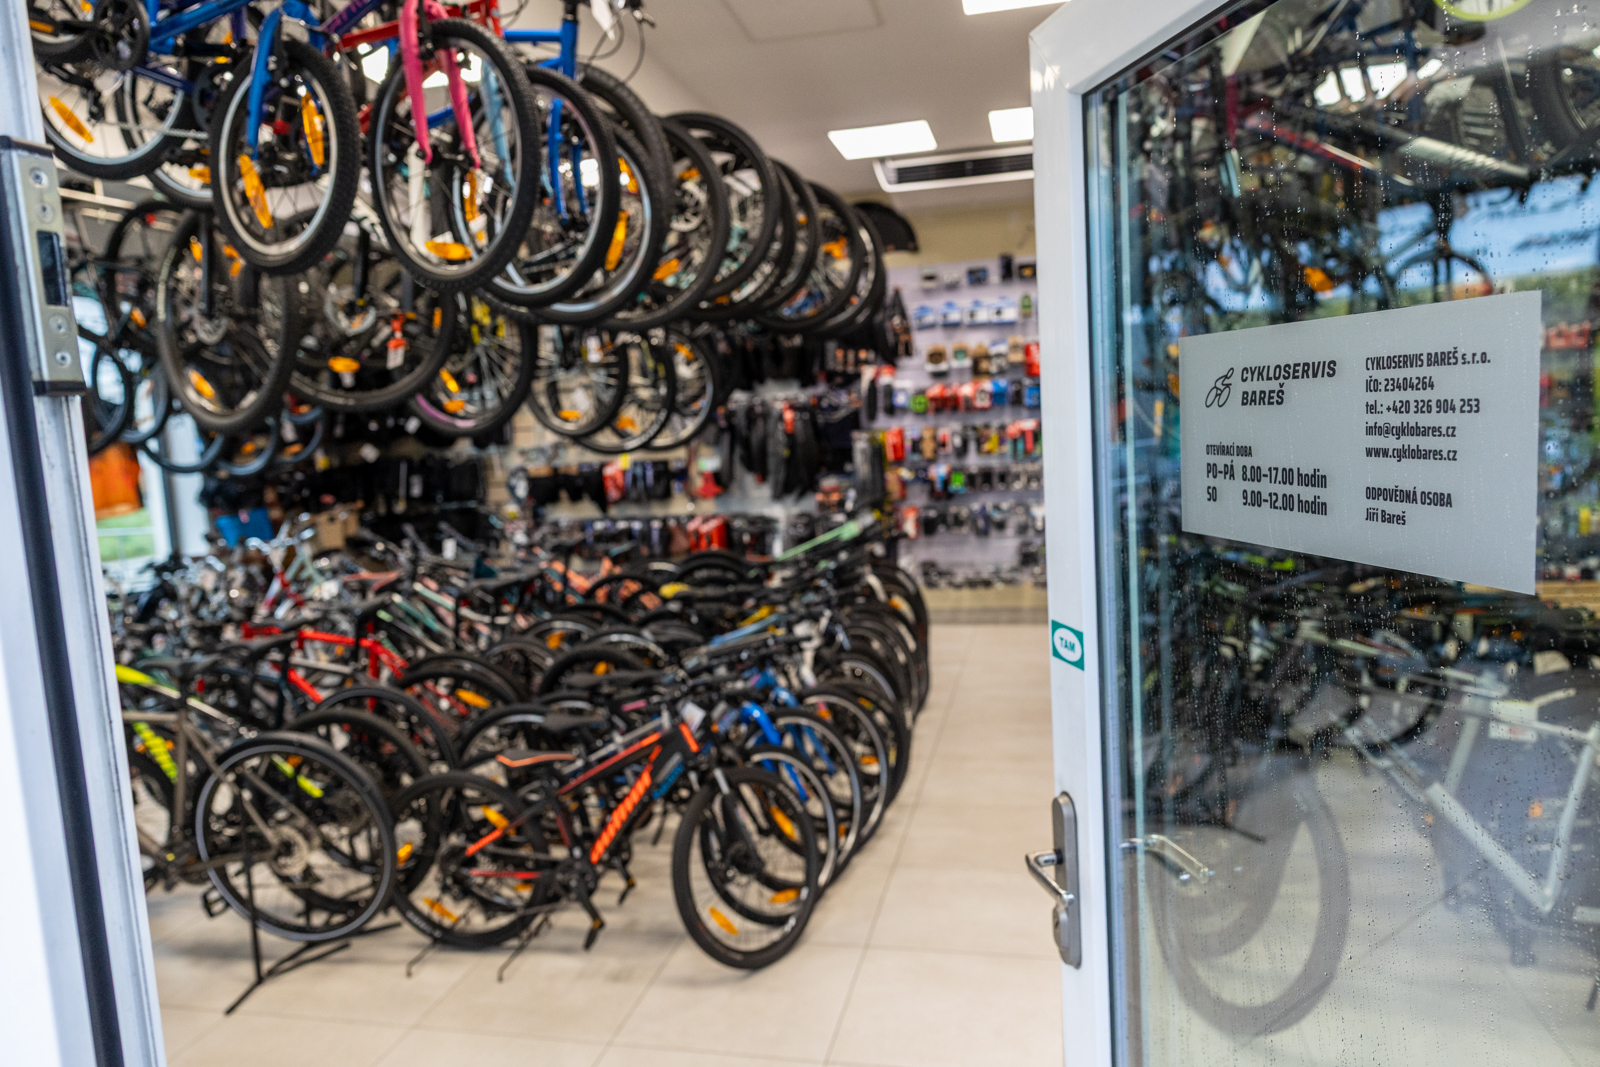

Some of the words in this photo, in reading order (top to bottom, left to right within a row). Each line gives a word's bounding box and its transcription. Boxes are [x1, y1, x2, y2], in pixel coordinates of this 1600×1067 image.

[1365, 353, 1424, 371] CYKLOSERVIS
[1426, 346, 1459, 367] BAREŠ
[1461, 351, 1491, 365] s.r.o.
[1240, 360, 1337, 382] CYKLOSERVIS
[1365, 375, 1382, 393] IČO:
[1384, 376, 1435, 392] 23404264
[1241, 382, 1285, 406] BAREŠ
[1365, 399, 1384, 415] tel.:
[1385, 399, 1411, 415] +420
[1413, 399, 1433, 414] 326
[1435, 398, 1456, 414] 904
[1459, 398, 1481, 414] 253
[1365, 421, 1457, 440] info@cyklobares.cz
[1205, 442, 1235, 457] OTEVÍRACÍ
[1236, 445, 1253, 458] DOBA
[1365, 444, 1458, 462] www.cyklobares.cz
[1241, 464, 1295, 486] 8.00-17.00
[1297, 467, 1328, 489] hodin
[1206, 485, 1218, 502] SO
[1242, 489, 1295, 512] 9.00-12.00
[1297, 493, 1328, 516] hodin
[1365, 485, 1418, 505] ODPOVĚDNÁ
[1420, 490, 1453, 508] OSOBA
[1365, 507, 1379, 522] Jiří
[1380, 509, 1407, 526] Bareš
[1059, 637, 1075, 653] TAM
